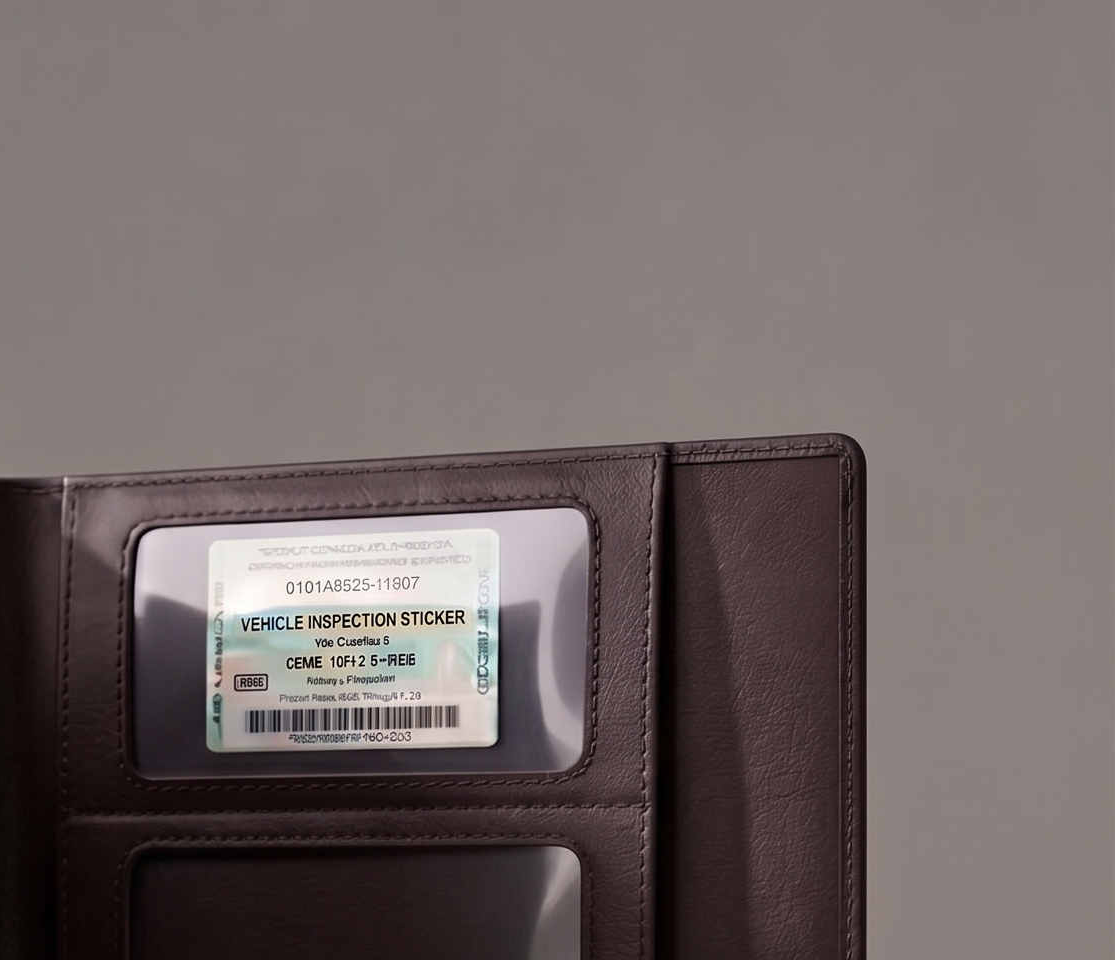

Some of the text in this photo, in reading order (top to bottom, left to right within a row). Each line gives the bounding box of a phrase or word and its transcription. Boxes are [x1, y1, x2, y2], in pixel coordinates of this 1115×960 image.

[241, 609, 466, 632] VEHICLE INSPECTION STICKER
[286, 656, 323, 670] CEME
